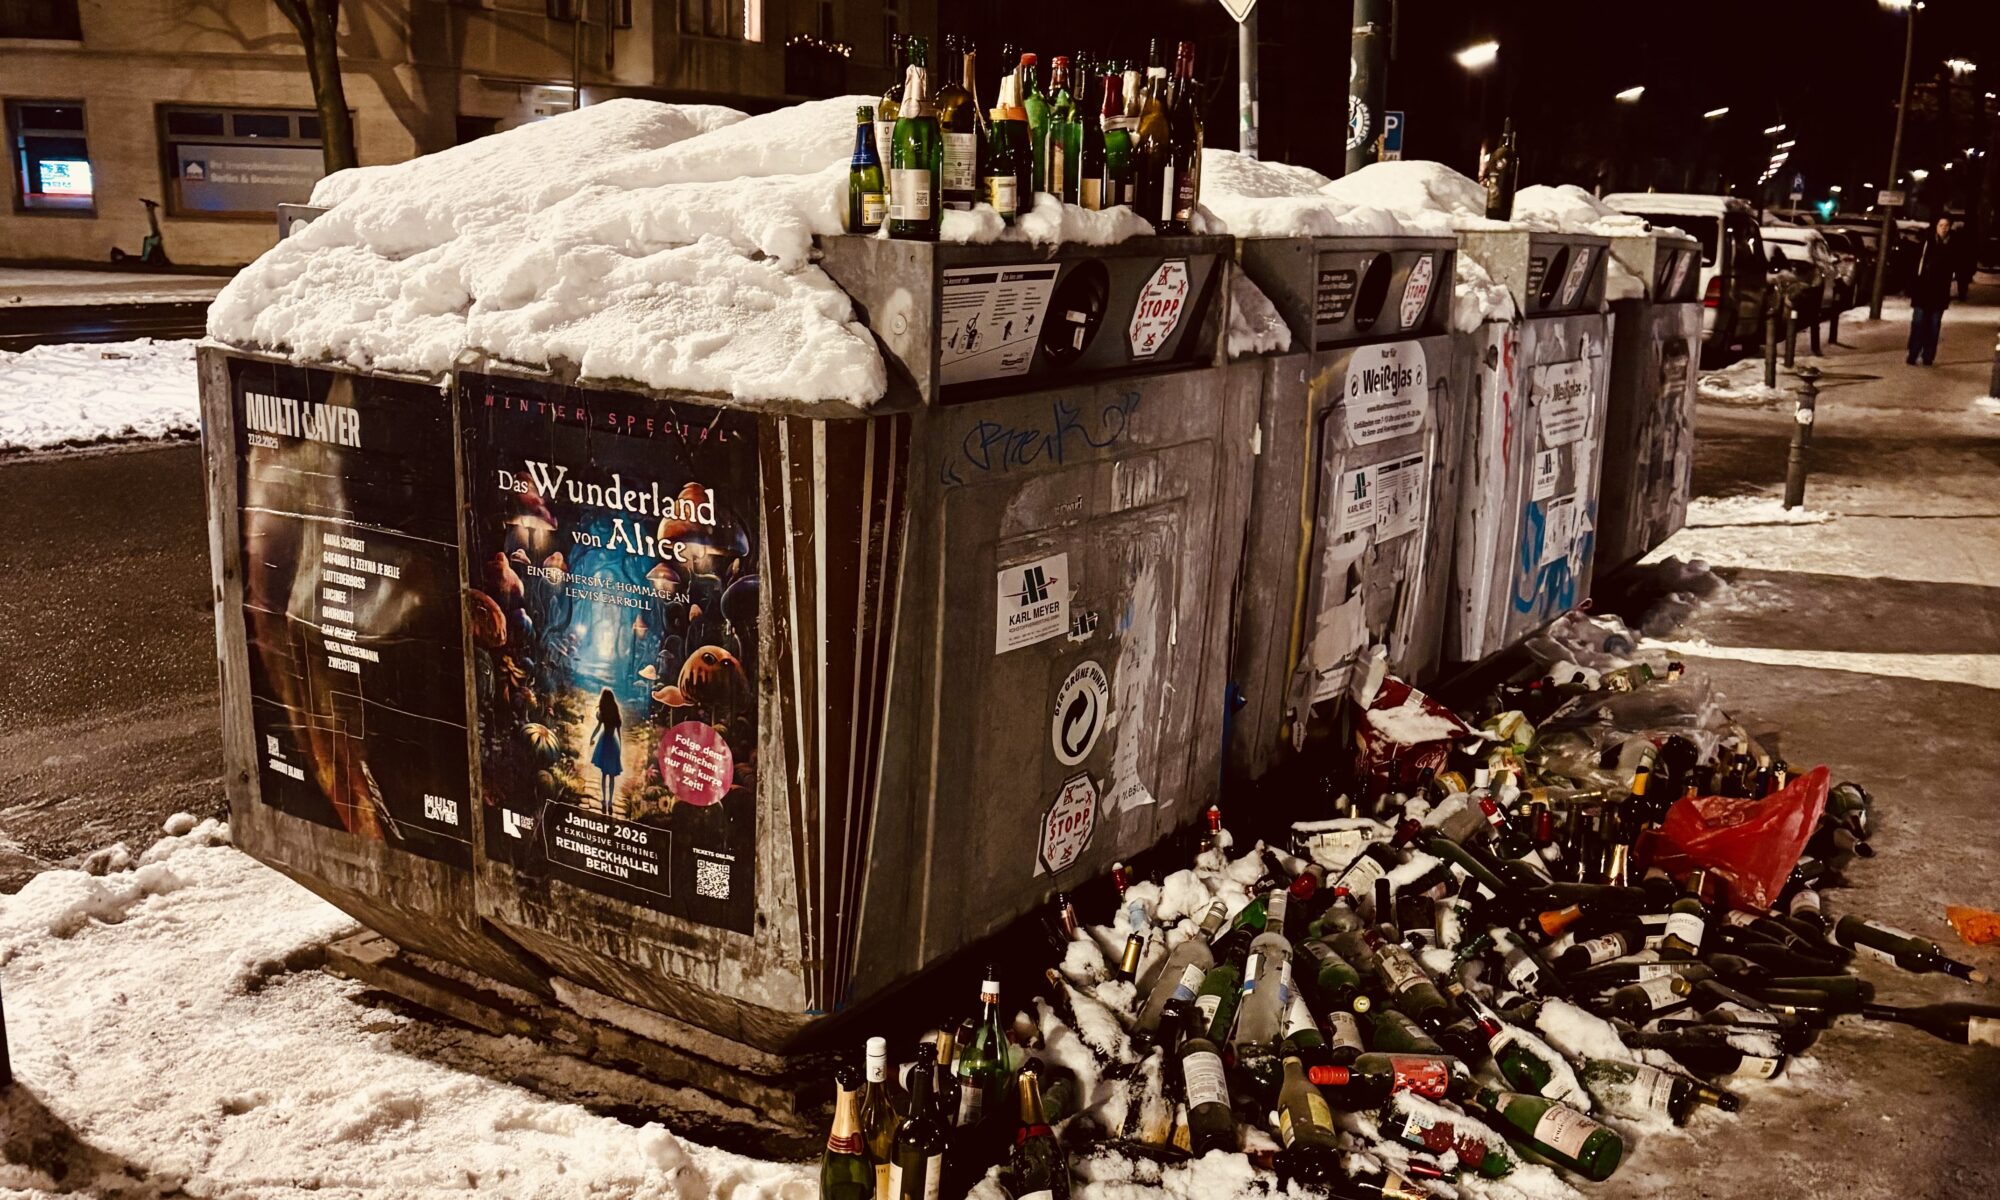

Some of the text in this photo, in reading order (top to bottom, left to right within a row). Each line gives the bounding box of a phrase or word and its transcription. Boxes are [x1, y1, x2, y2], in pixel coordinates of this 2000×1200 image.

[1384, 116, 1398, 138] P
[1138, 299, 1180, 319] STOPP
[1363, 363, 1412, 396] Weißglas
[245, 391, 361, 448] MULTI LAYER
[485, 395, 728, 443] WINTER SPECIAL
[498, 459, 717, 527] Das Wunderland
[572, 518, 687, 562] von Alice
[527, 566, 690, 604] EINE IMMERSIVE HOMMAGE AN
[566, 587, 651, 611] LEWIS CARROLL
[1009, 601, 1060, 627] KARL MEYER
[1054, 667, 1107, 717] DER GRÜNE PUNKT
[671, 745, 718, 773] Kaninchen
[675, 734, 723, 761] Folge dem
[664, 757, 723, 787] nur für kurze
[682, 776, 704, 792] Zeit!
[424, 793, 458, 814] MULTI
[424, 805, 459, 826] LAYER
[564, 812, 648, 844] Januar 2026
[564, 827, 612, 847] EXKLUSIVE
[1049, 808, 1090, 841] STOPP
[555, 836, 658, 875] REINBECKHALLEN
[586, 857, 629, 879] BERLIN
